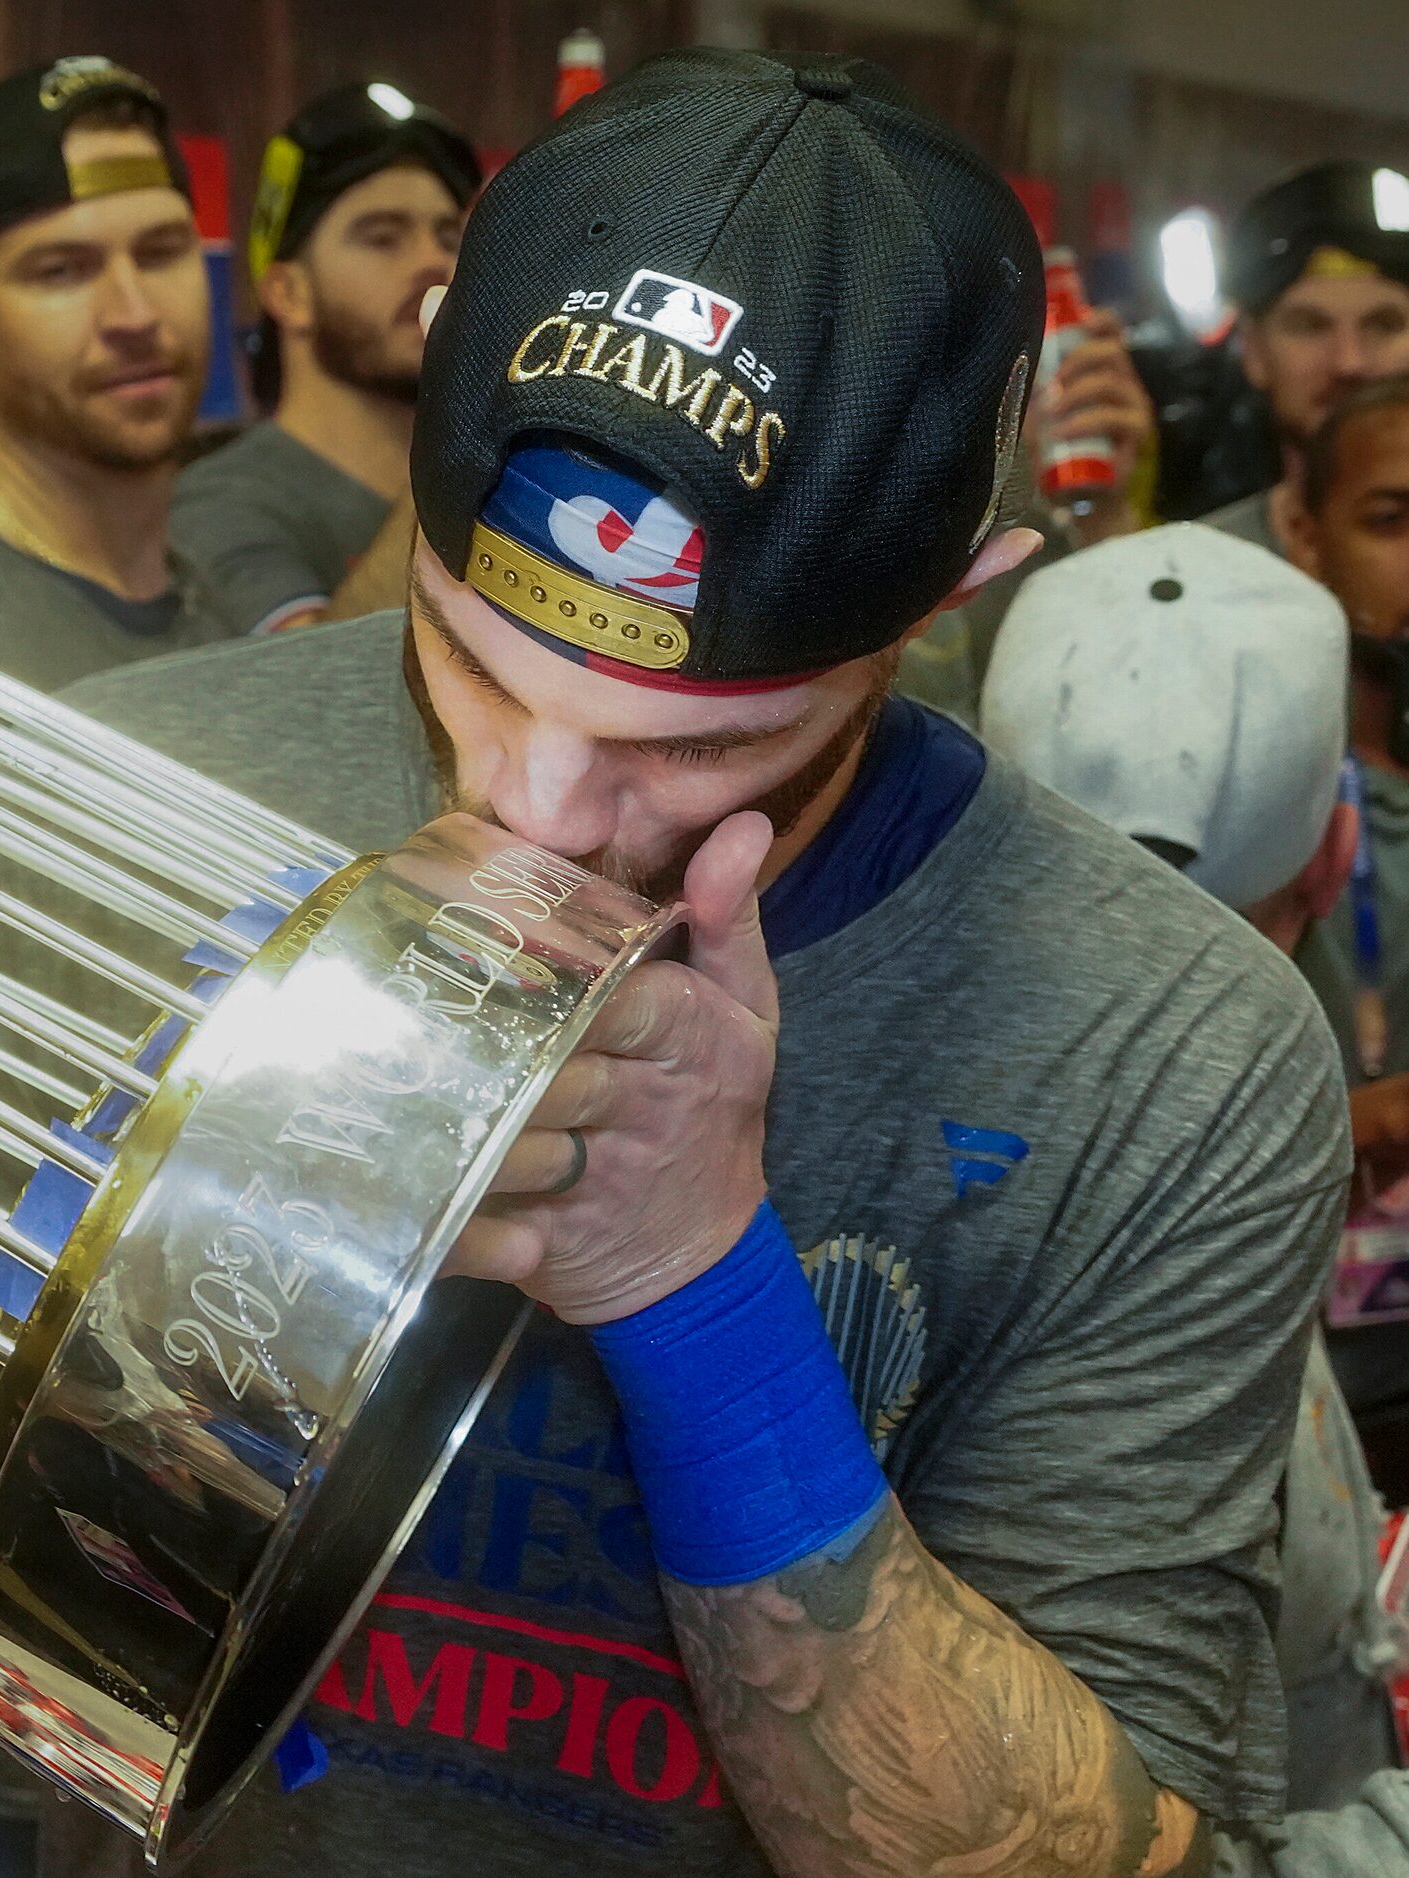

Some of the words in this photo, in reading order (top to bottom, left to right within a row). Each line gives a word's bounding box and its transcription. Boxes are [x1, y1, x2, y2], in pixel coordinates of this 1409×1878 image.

[507, 315, 787, 489] CHAMPS
[560, 289, 609, 312] 20
[733, 346, 777, 394] 23
[163, 1171, 335, 1401] 2023
